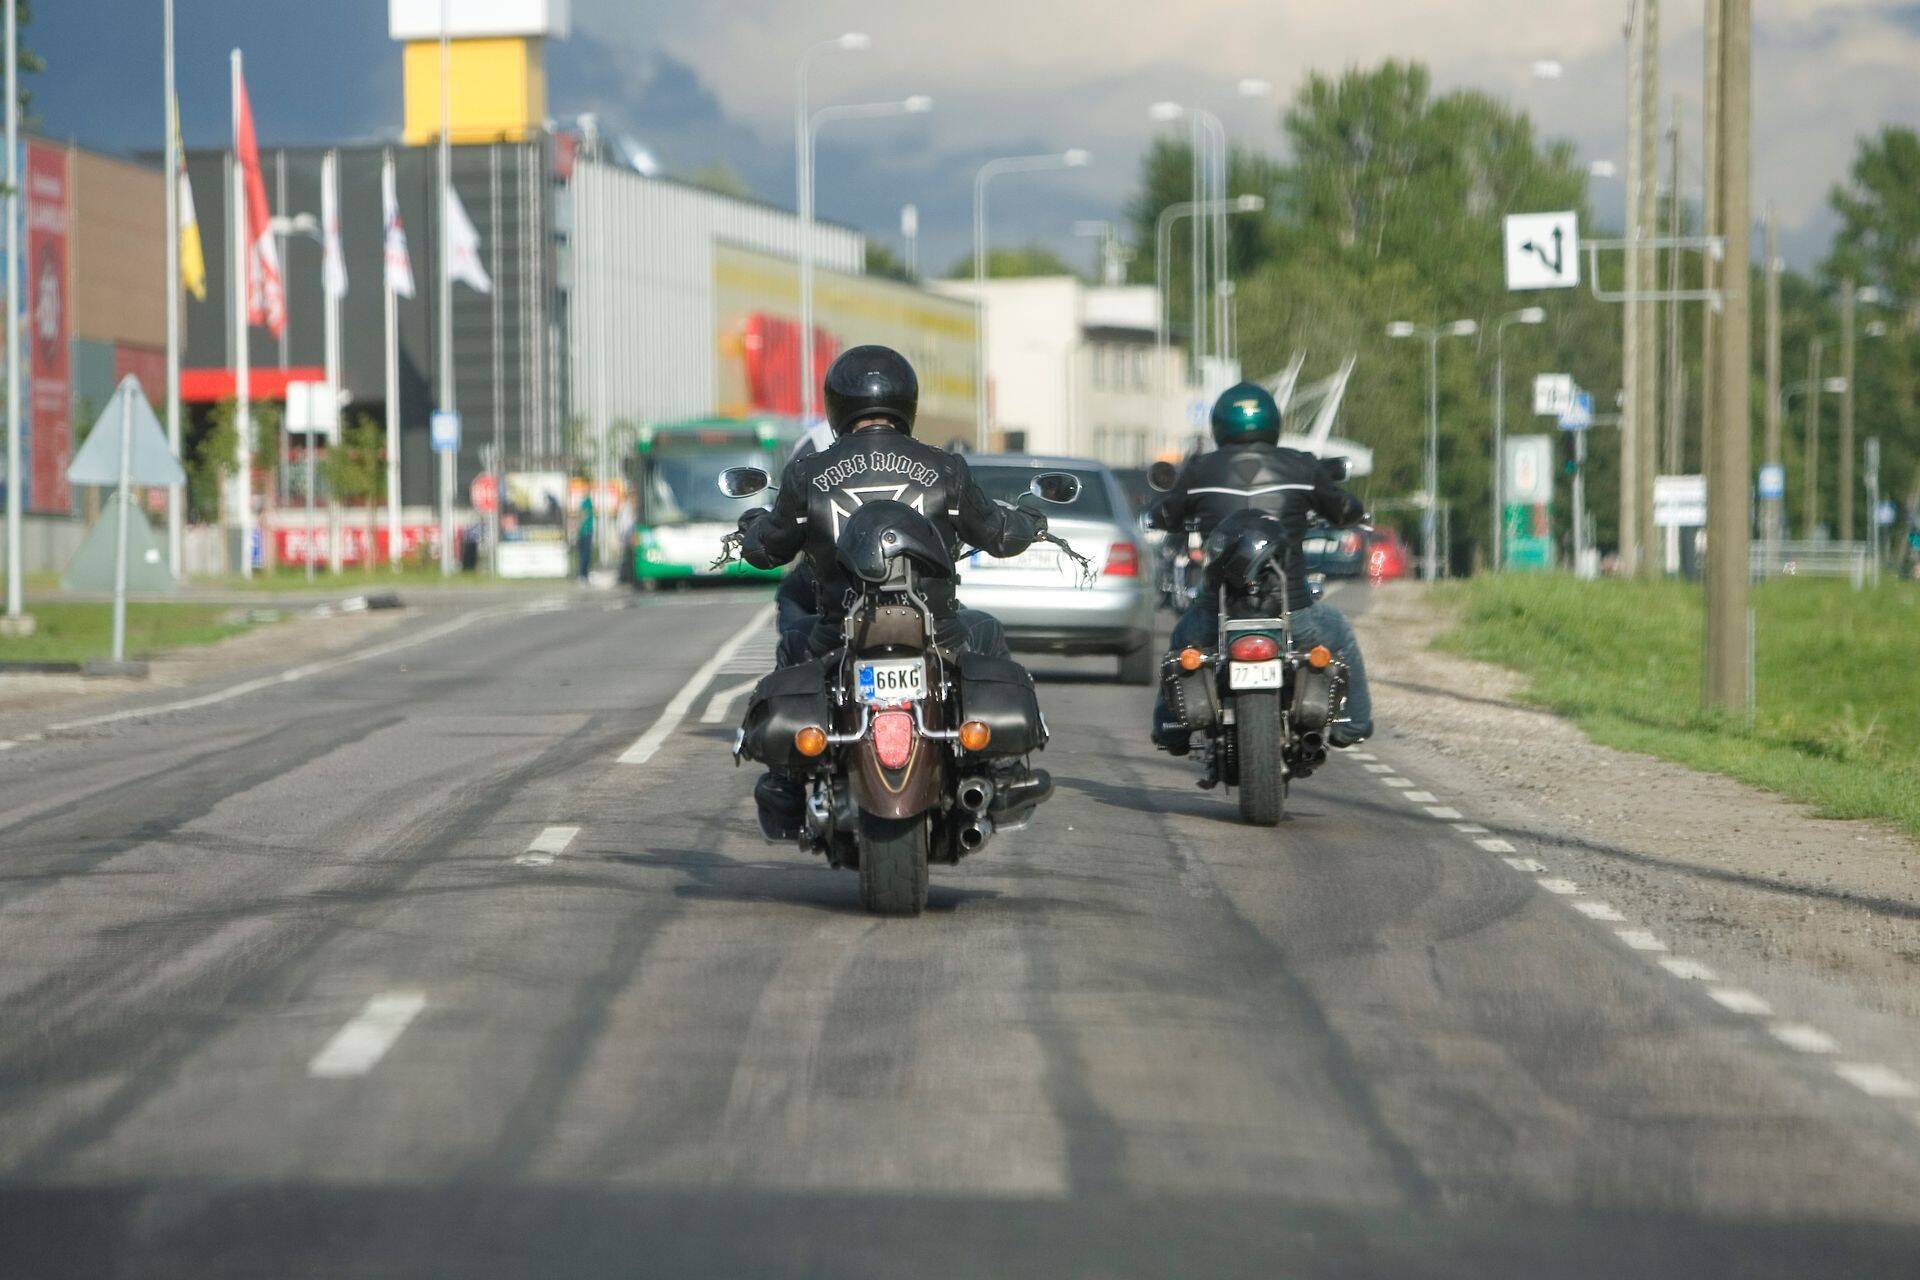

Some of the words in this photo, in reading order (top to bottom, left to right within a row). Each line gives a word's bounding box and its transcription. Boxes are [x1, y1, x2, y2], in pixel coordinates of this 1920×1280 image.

[814, 454, 868, 491] FREE
[870, 451, 939, 487] RIDER
[876, 668, 920, 690] 66KG
